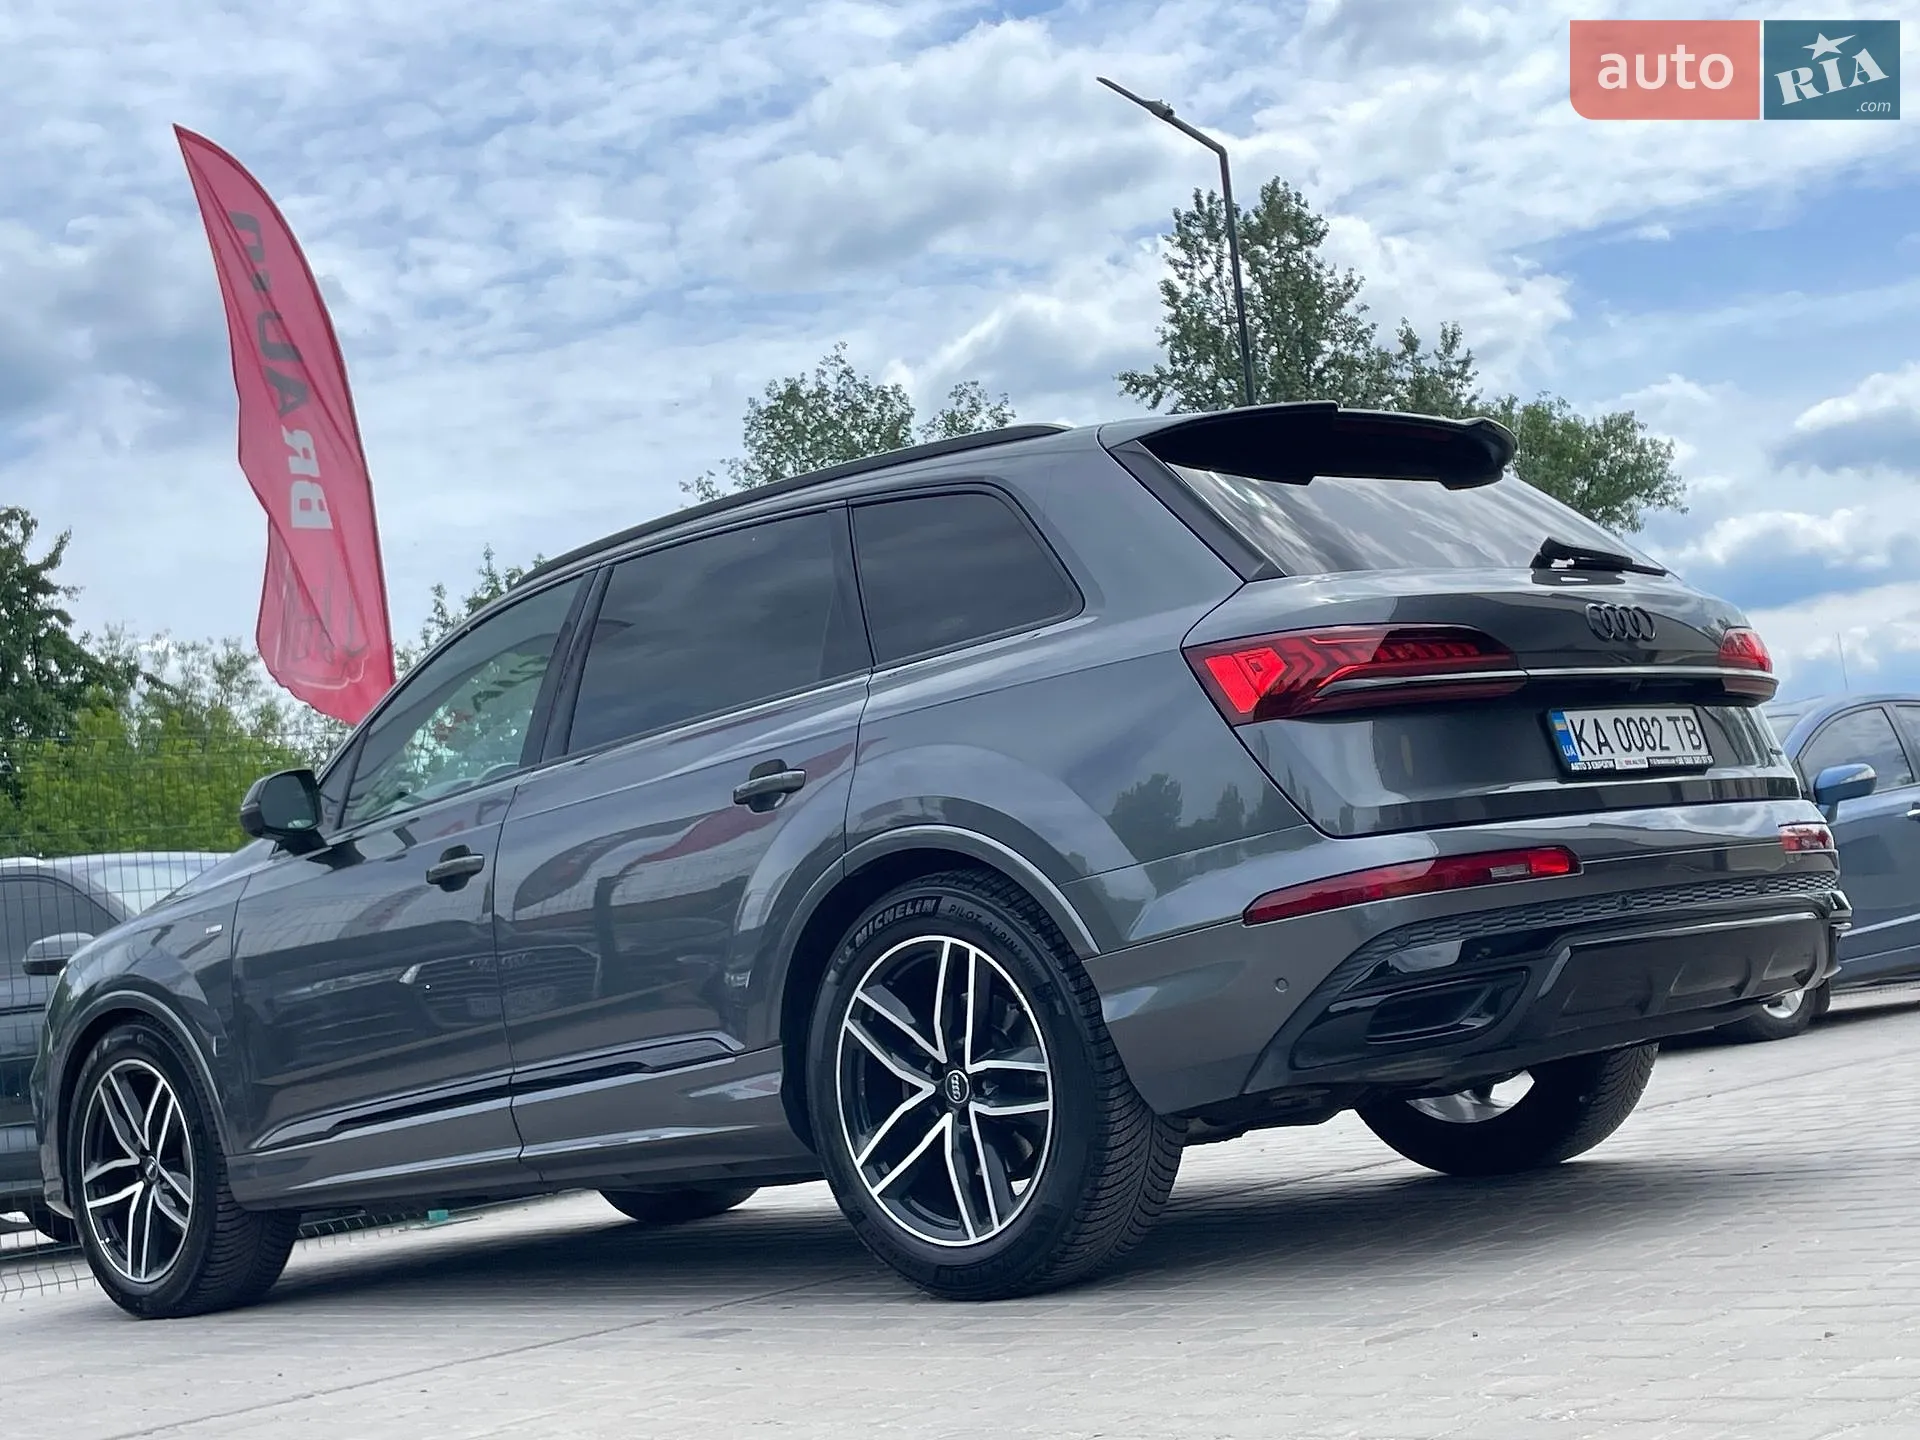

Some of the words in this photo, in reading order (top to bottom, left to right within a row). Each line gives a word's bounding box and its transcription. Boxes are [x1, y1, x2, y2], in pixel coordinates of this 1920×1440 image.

[1562, 745, 1577, 757] UA
[1570, 717, 1615, 756] KA
[1614, 716, 1670, 752] 0082
[1667, 716, 1702, 750] TB
[855, 899, 938, 948] MICHELIN
[949, 904, 982, 921] PILOT
